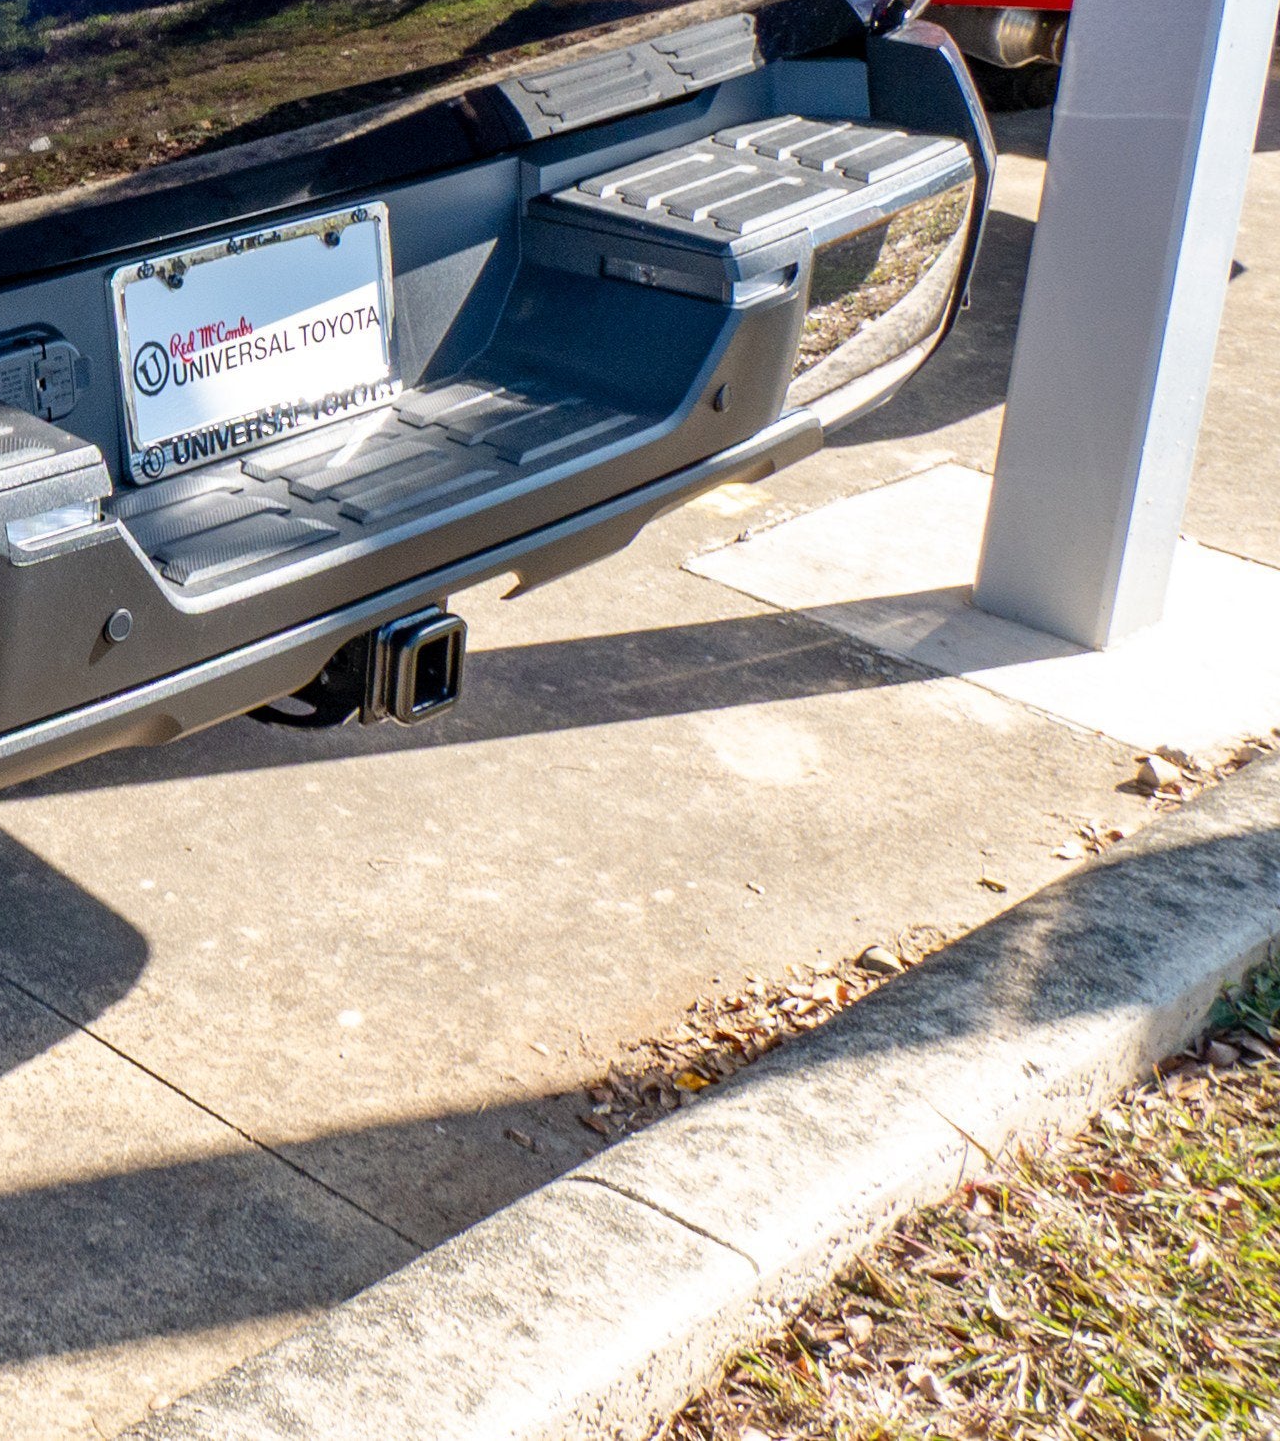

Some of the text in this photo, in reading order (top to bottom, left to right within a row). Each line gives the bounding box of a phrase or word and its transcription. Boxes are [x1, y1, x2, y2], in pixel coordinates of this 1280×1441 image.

[170, 316, 254, 363] Red McCombs
[173, 306, 380, 386] UNIVERSAL TOYOTA
[173, 378, 394, 465] UNIVERSAL TOYOTA
